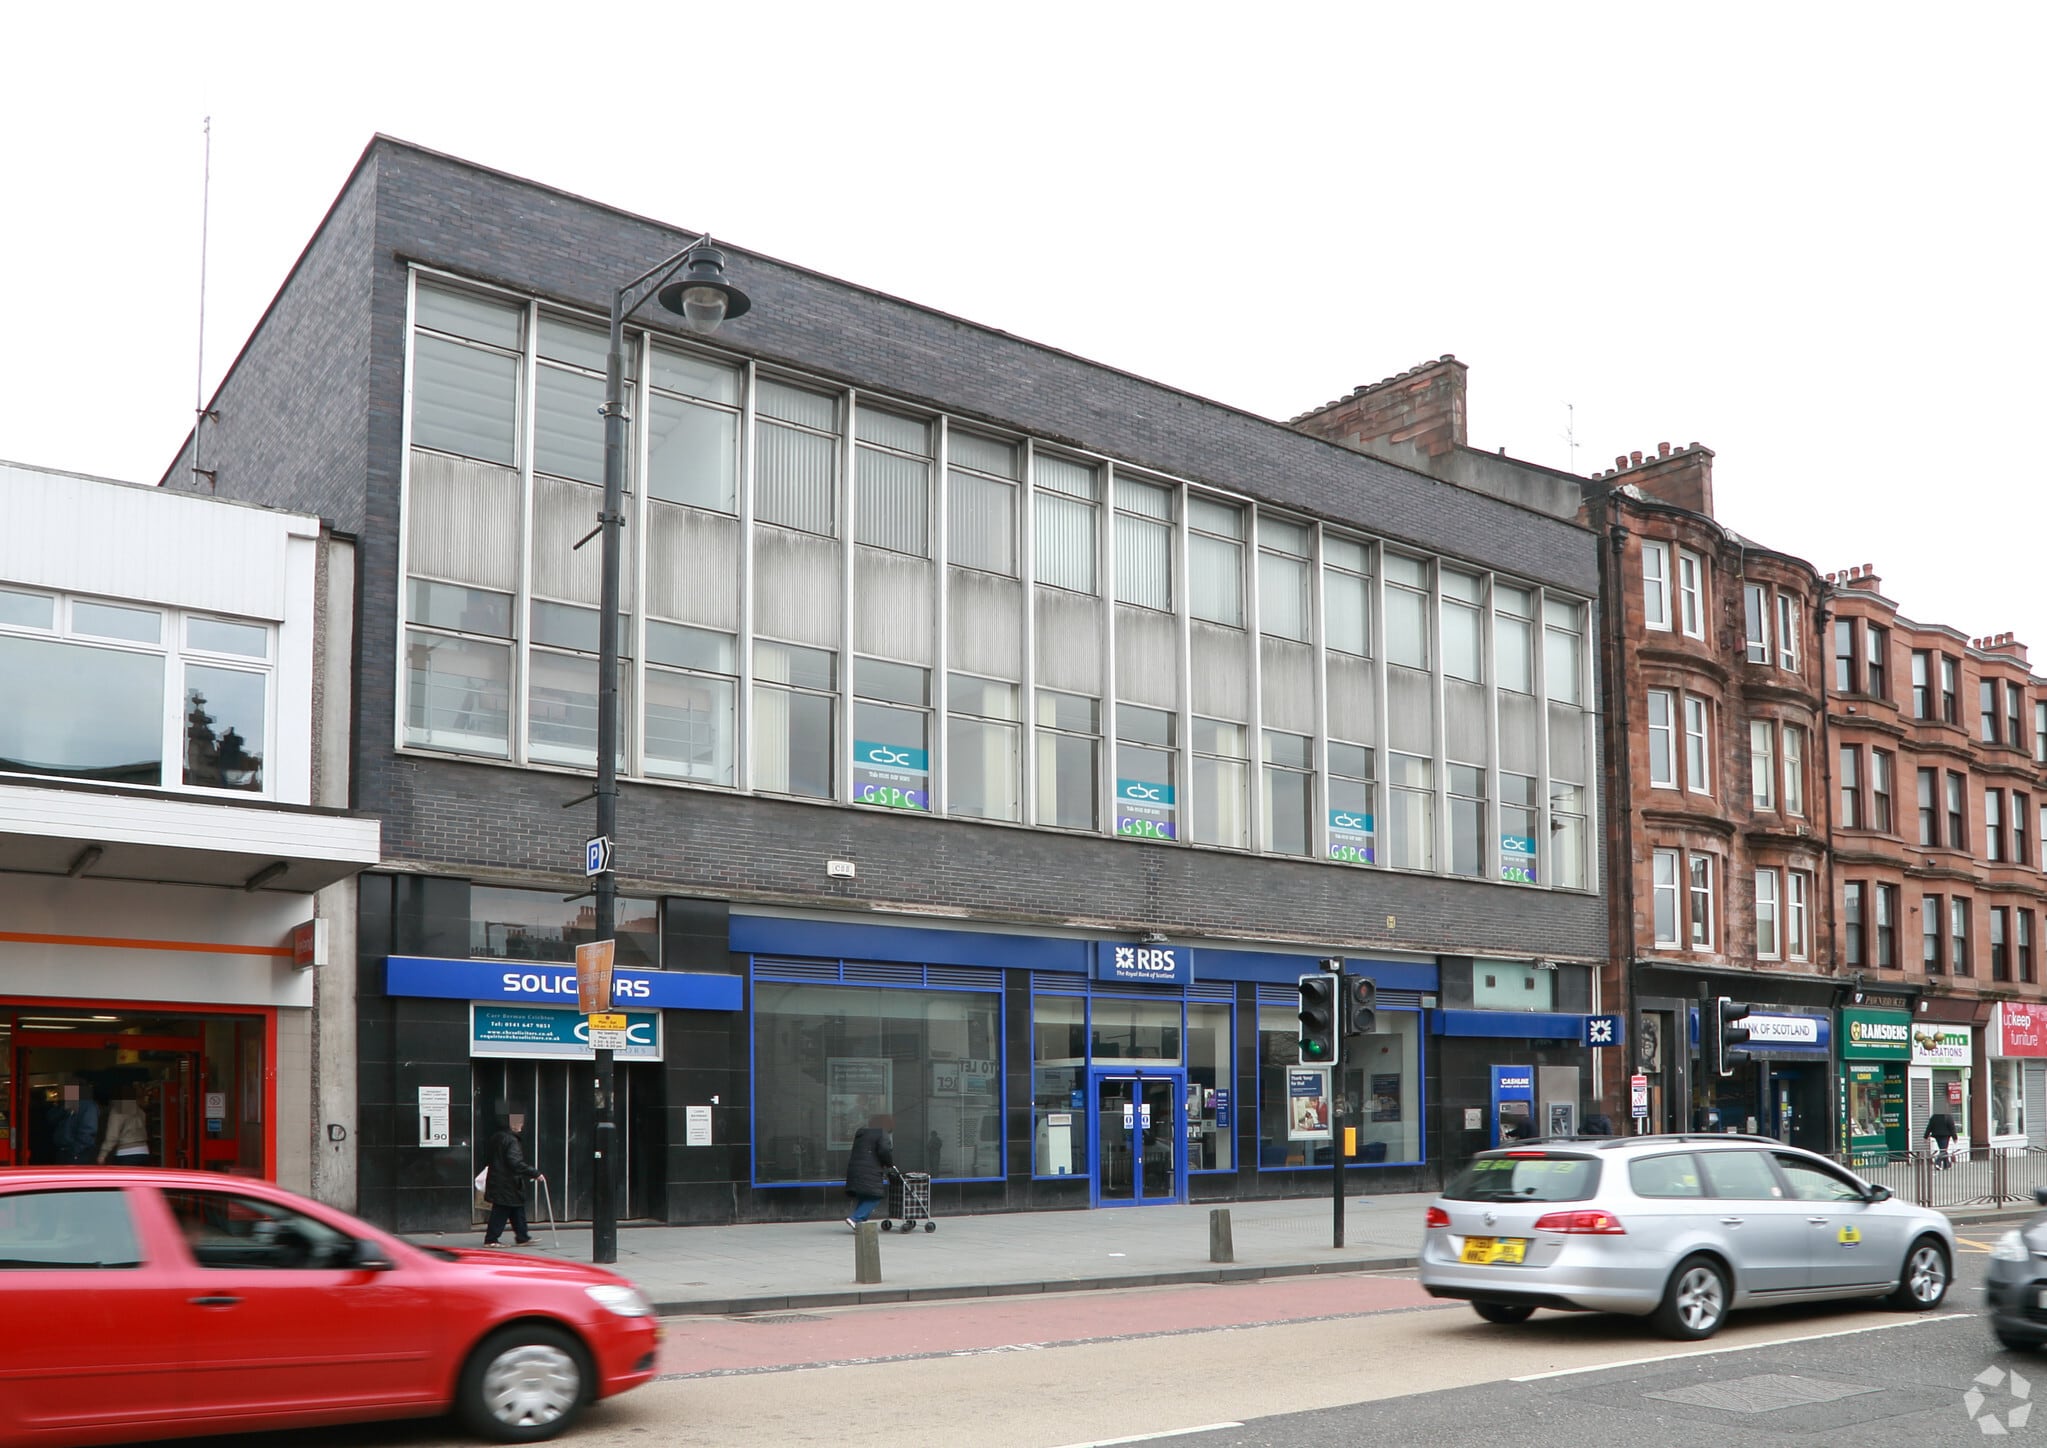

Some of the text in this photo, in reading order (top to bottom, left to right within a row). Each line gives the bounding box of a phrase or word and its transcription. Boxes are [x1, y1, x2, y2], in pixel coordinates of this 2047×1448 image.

[864, 785, 916, 807] GSPC
[1122, 818, 1165, 838] GSPC
[590, 846, 599, 869] P
[1331, 844, 1366, 862] GSPC
[1501, 866, 1530, 882] GSPC
[1137, 949, 1175, 971] RBS
[503, 974, 650, 997] SOLICRS
[1760, 1023, 1770, 1034] OF
[1772, 1024, 1809, 1036] SCOTLAND
[2004, 1011, 2031, 1030] upkeep
[1861, 1023, 1908, 1040] RAMSDENS
[2011, 1030, 2038, 1046] furniture
